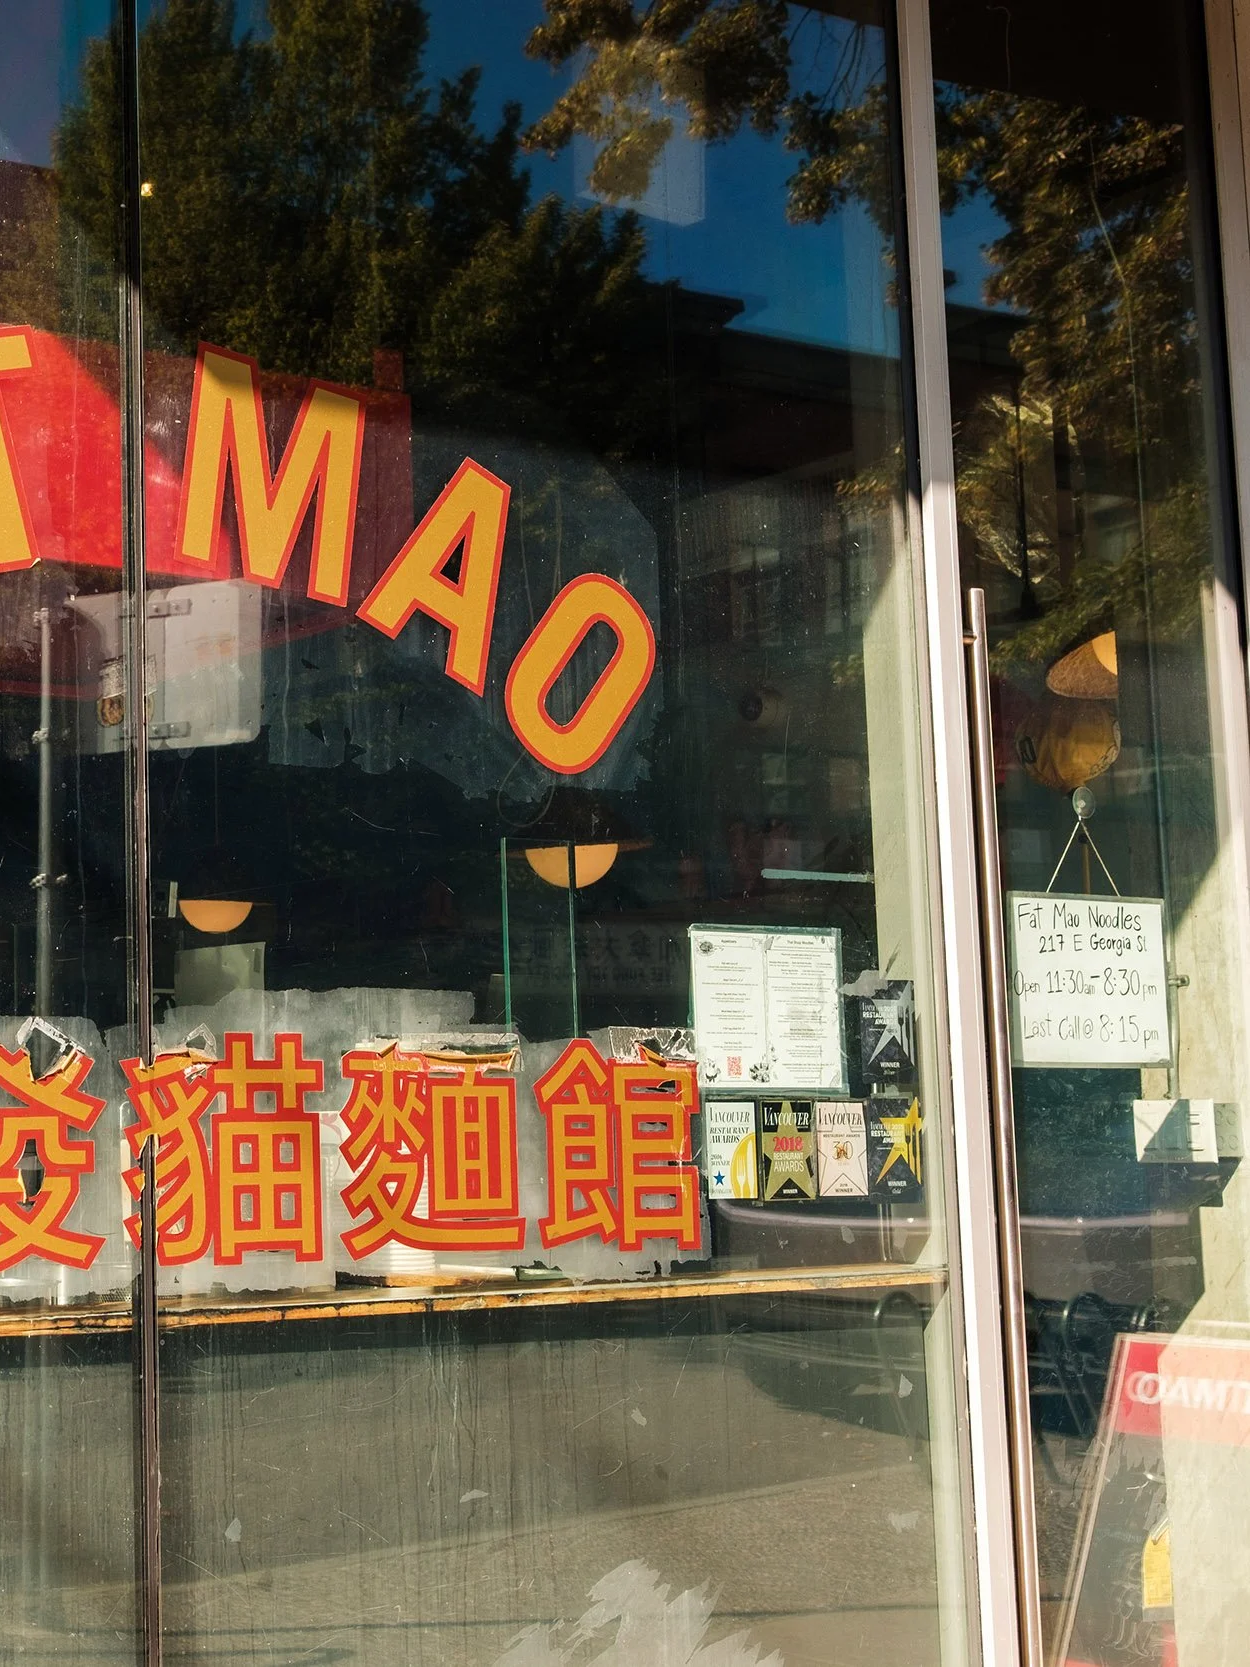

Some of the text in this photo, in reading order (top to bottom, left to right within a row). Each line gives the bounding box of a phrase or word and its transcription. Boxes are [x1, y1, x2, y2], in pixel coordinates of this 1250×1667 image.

[174, 340, 656, 775] MAO
[1017, 902, 1142, 932] Fat Mao Noodles
[1038, 934, 1065, 954] 217
[1073, 934, 1083, 952] E
[1090, 933, 1132, 957] Georgia
[1013, 970, 1041, 1002] Open
[1024, 1013, 1053, 1040] Last
[709, 1107, 750, 1124] VANCOUVER
[763, 1107, 810, 1126] VANCOUVER
[818, 1108, 863, 1126] VANCOUVER
[709, 1126, 750, 1135] RESTAURANT
[709, 1135, 741, 1144] AWARDS
[773, 1136, 804, 1153] 2018
[773, 1152, 804, 1161] RESTAURANT
[773, 1160, 805, 1173] AWARDS
